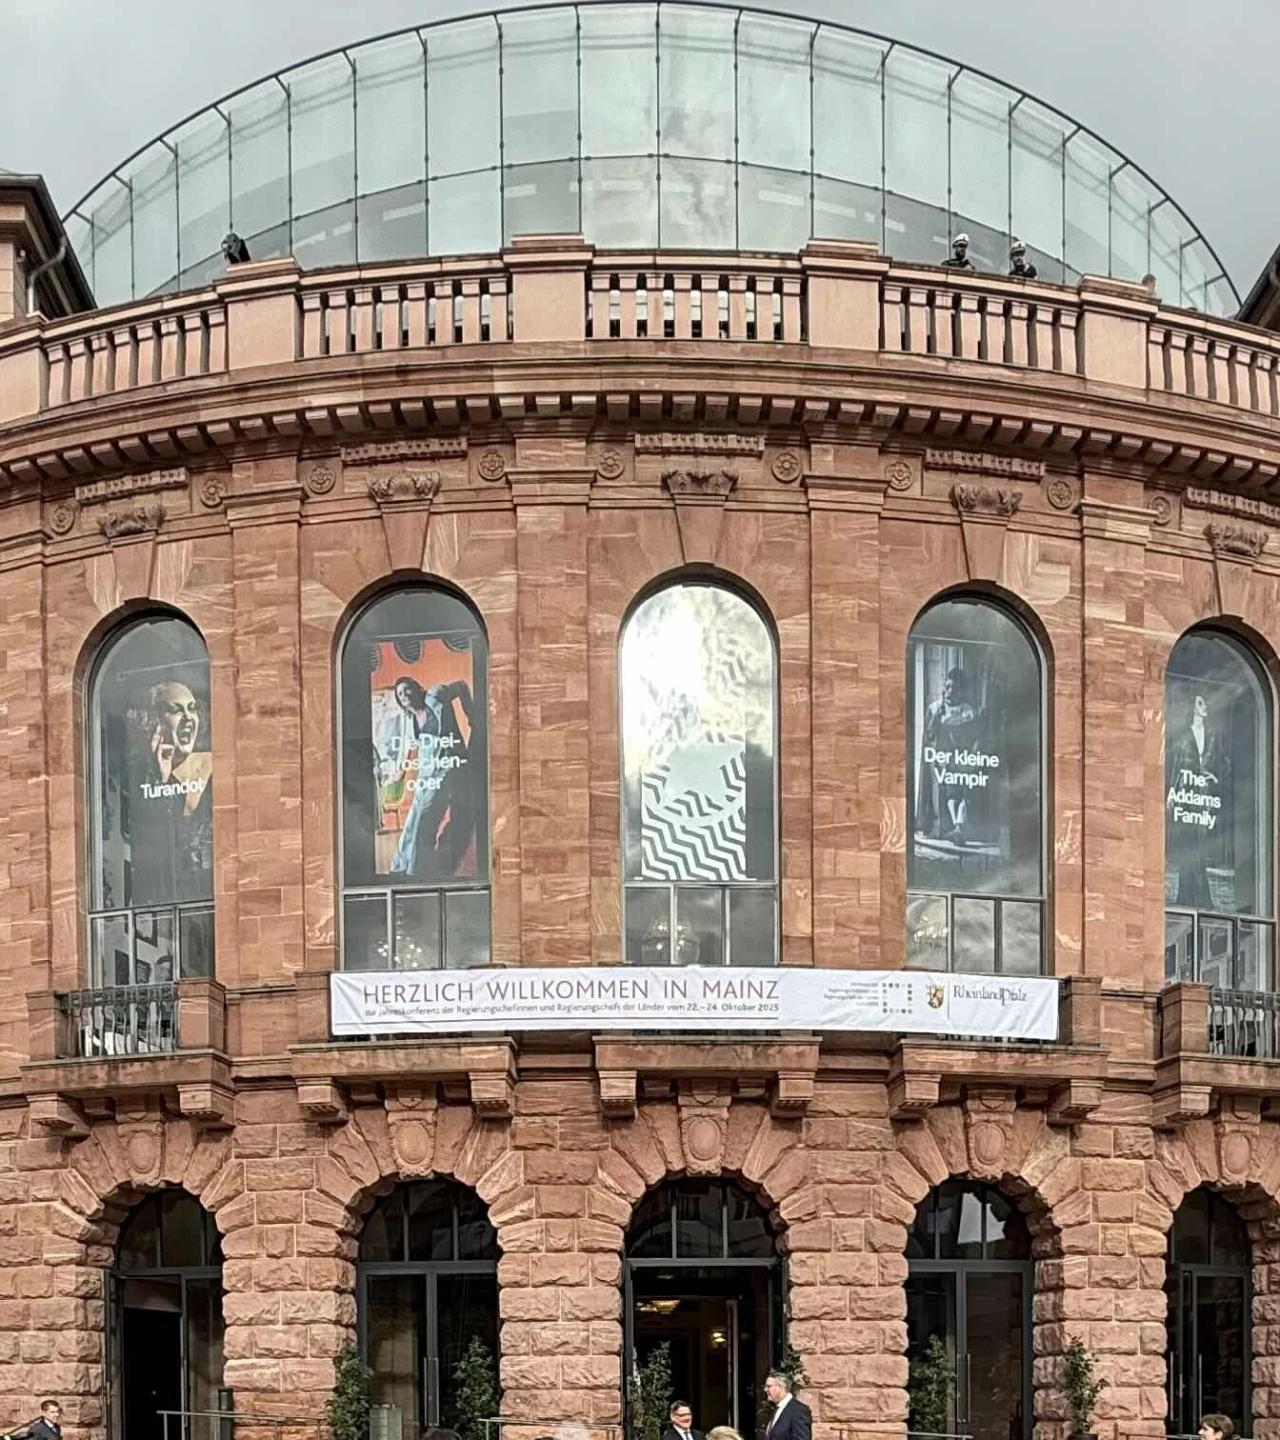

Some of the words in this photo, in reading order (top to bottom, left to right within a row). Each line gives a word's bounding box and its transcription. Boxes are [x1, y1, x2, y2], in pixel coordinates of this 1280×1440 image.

[419, 732, 461, 749] Drei-
[924, 747, 952, 765] Der
[955, 749, 1000, 768] kleine
[140, 777, 206, 799] Turandot
[406, 777, 443, 795] oper
[934, 767, 989, 789] Vampir
[1180, 769, 1207, 787] The
[1167, 787, 1221, 808] Addams
[1174, 806, 1216, 829] Family
[364, 982, 473, 1004] HERZLICH
[486, 980, 648, 1000] WILLKOMMEN
[664, 980, 687, 998] IN
[702, 980, 779, 999] MAINZ
[540, 1003, 555, 1011] und
[721, 1003, 756, 1011] Oktober
[758, 1003, 779, 1011] 2025
